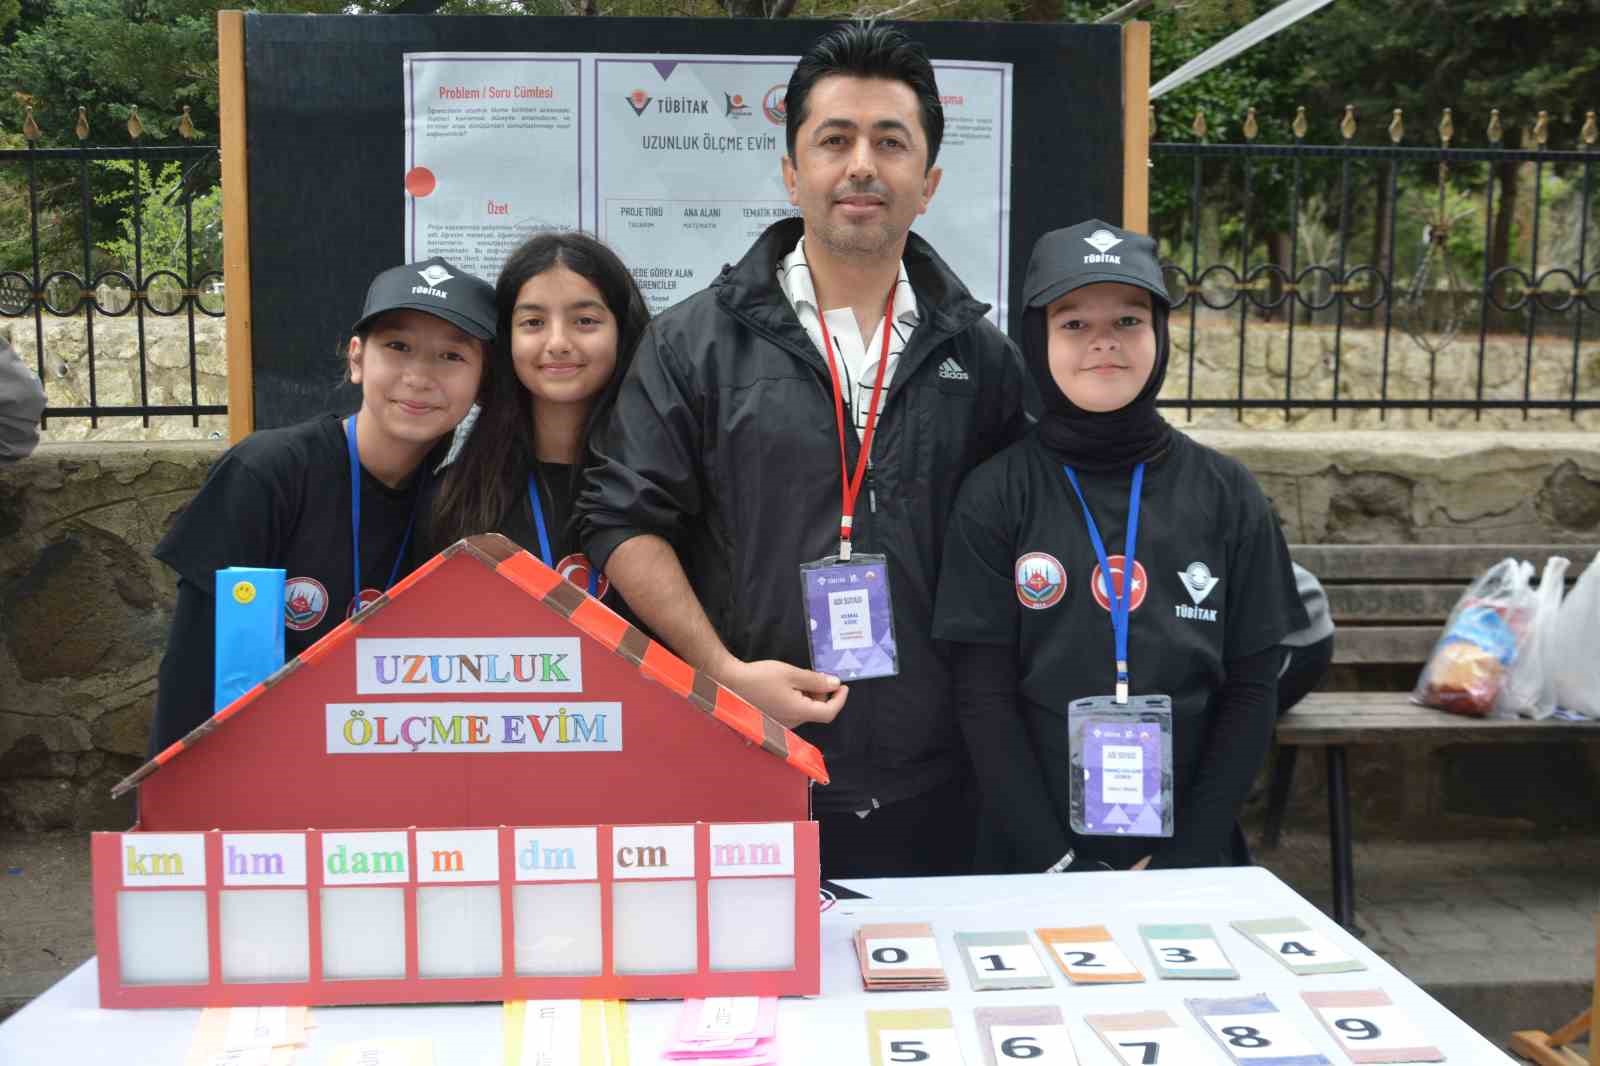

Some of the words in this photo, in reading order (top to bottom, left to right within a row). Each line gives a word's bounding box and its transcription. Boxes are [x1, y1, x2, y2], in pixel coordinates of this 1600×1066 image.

[439, 86, 480, 99] Problem
[488, 86, 511, 98] Soru
[514, 85, 553, 99] Cümlesi
[658, 96, 709, 114] TÜBİTAK
[642, 135, 699, 150] UZUNLUK
[703, 132, 743, 154] ÖLÇME
[747, 133, 776, 151] EVİM
[487, 200, 509, 215] Özet
[621, 207, 643, 217] PROJE
[684, 207, 699, 217] ANA
[699, 207, 721, 218] ALANI
[1083, 252, 1121, 265] TÜBİTAK
[649, 265, 673, 278] GÖREV
[675, 267, 694, 279] ALAN
[411, 285, 448, 299] TÜBİTAK
[938, 370, 969, 380] adidas
[1175, 603, 1218, 622] TÜBİTAK
[373, 653, 571, 684] UZUNLUK
[342, 709, 491, 752] ÖLÇME
[501, 707, 608, 744] EVİM
[125, 844, 184, 876] km
[226, 845, 284, 875] hm
[326, 844, 406, 874] dam
[431, 846, 465, 872] m
[518, 840, 577, 870] dm
[616, 842, 670, 868] cm
[712, 840, 782, 867] mm
[871, 946, 909, 964] 0
[1063, 951, 1106, 967] 2
[1159, 947, 1198, 963] 3
[1279, 941, 1316, 957] 4
[979, 954, 1017, 972] 1
[1221, 1025, 1272, 1048] 8
[1334, 1017, 1382, 1041] 9
[890, 1041, 930, 1063] 5
[1000, 1036, 1044, 1060] 6
[1118, 1041, 1160, 1065] 7
